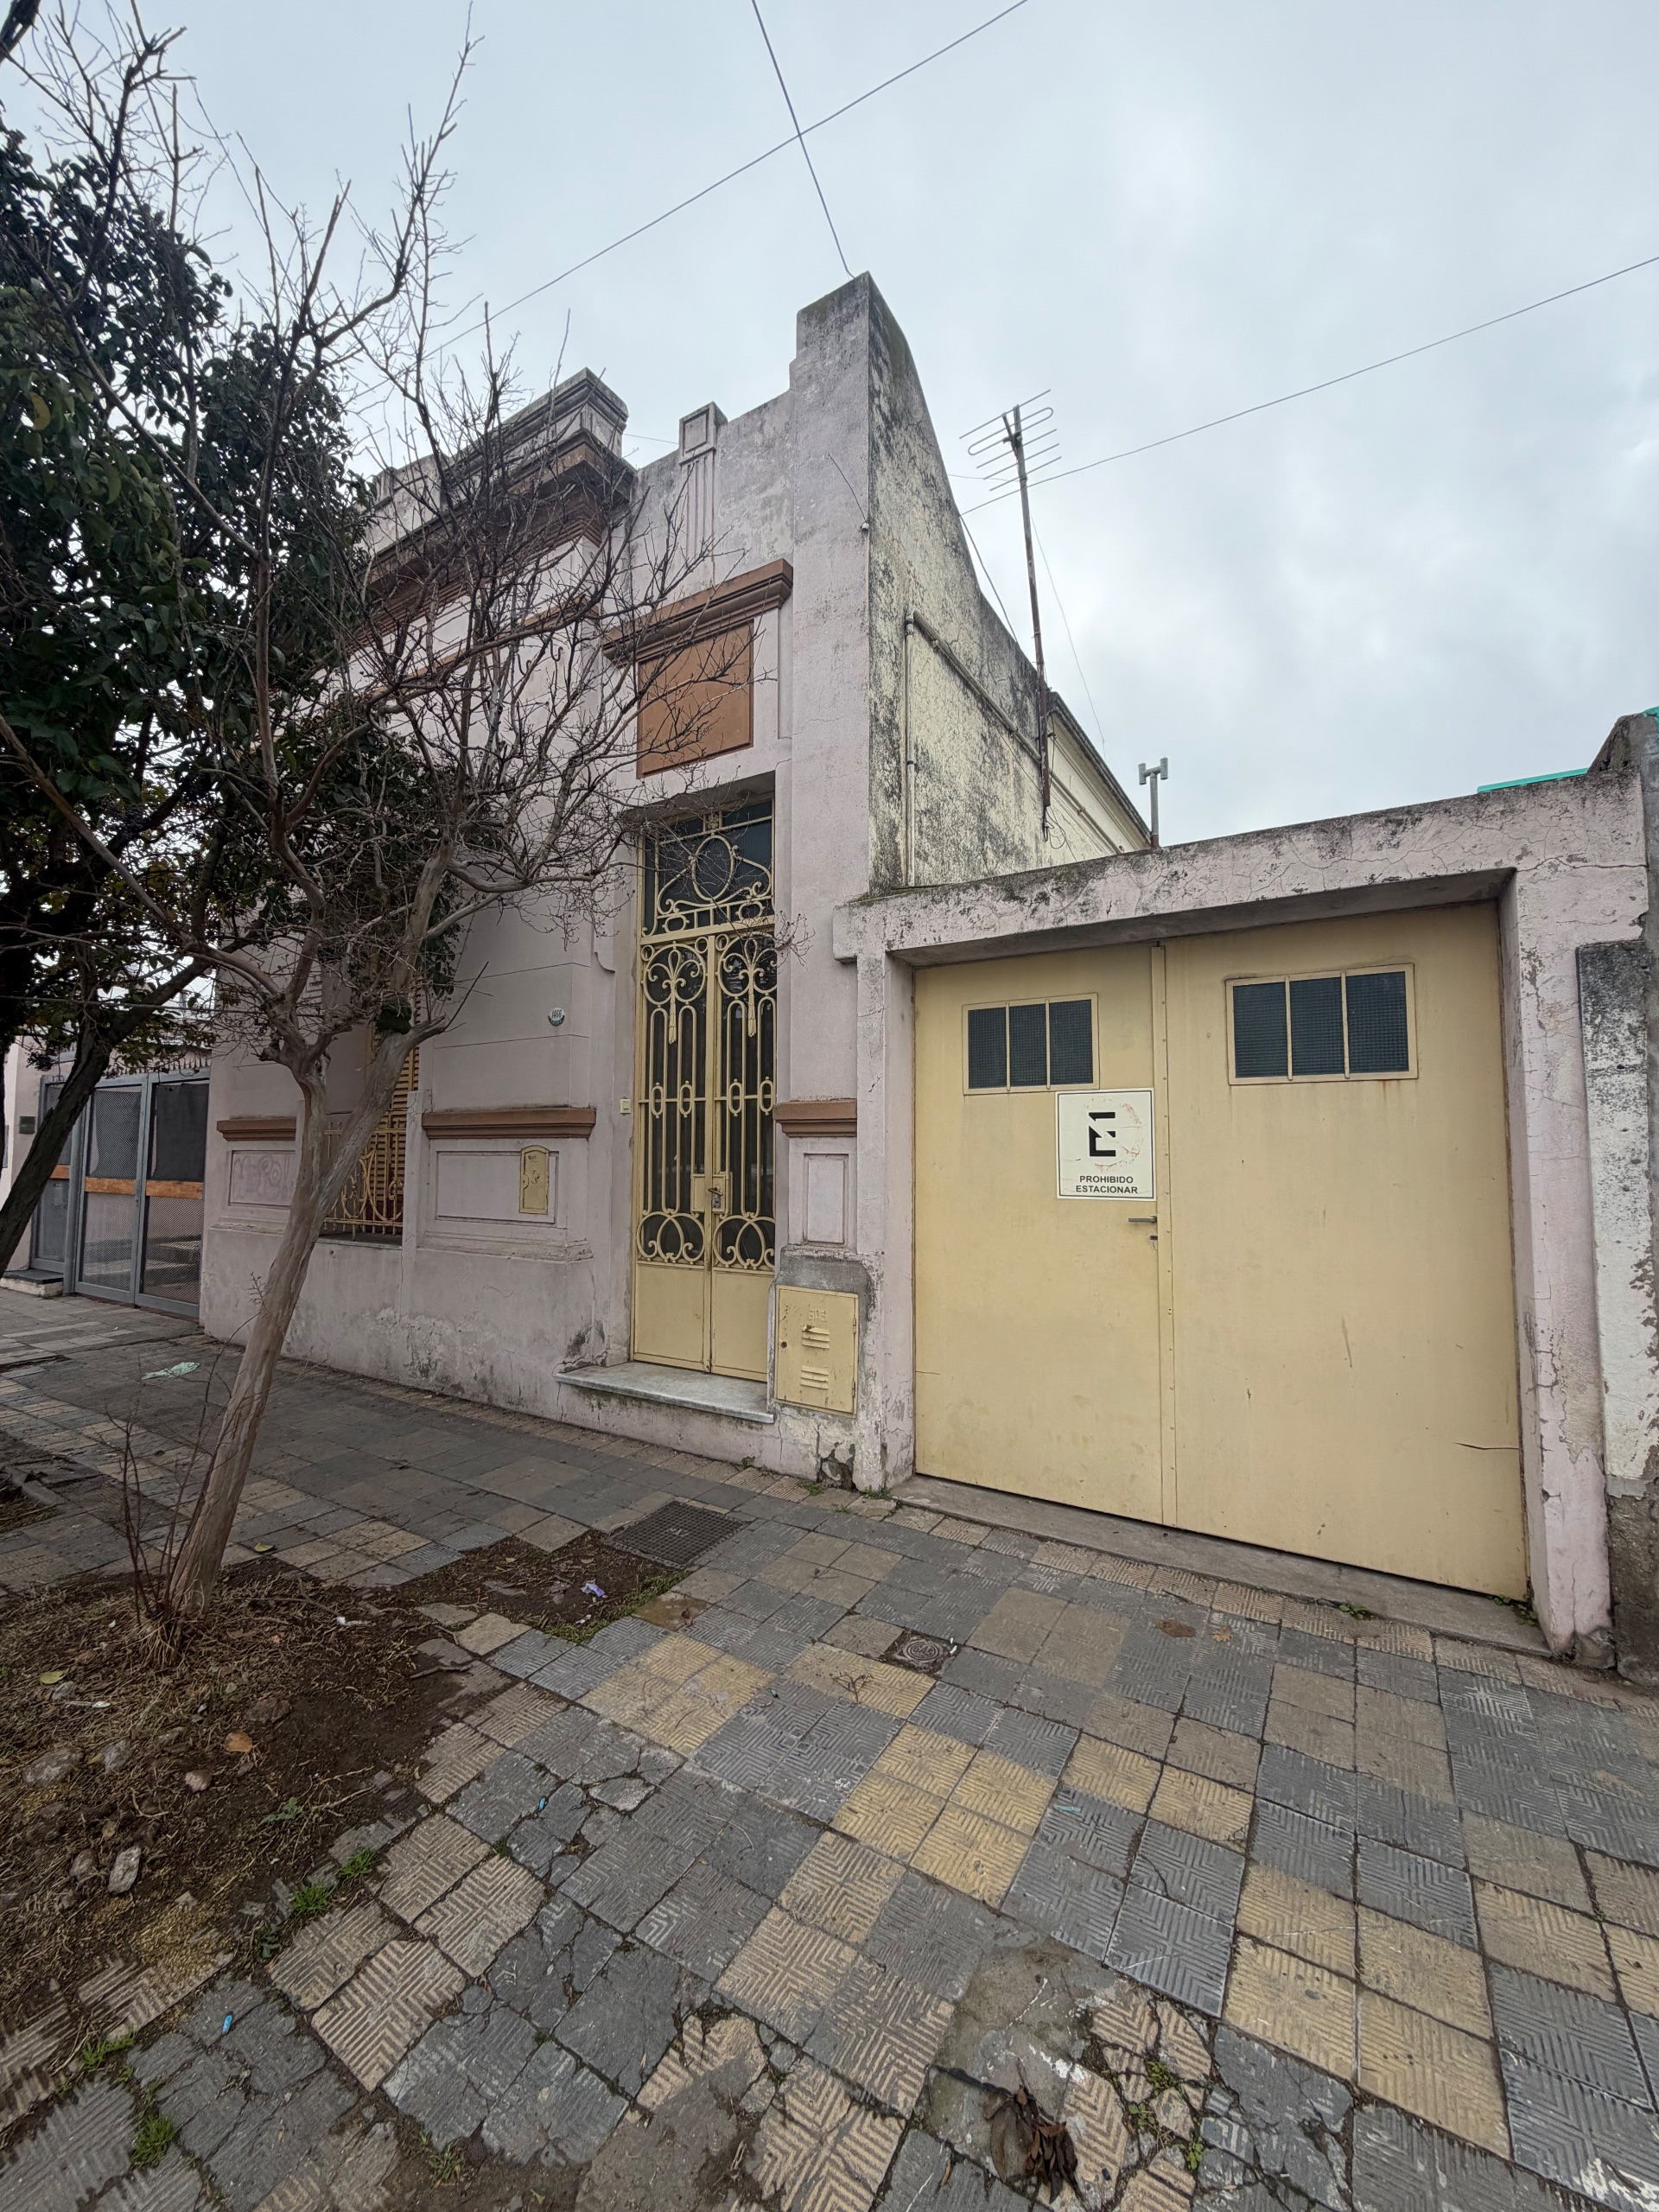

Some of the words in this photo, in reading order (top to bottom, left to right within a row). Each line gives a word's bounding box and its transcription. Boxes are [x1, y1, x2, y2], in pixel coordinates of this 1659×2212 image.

[1088, 1111, 1116, 1157] E
[1079, 1175, 1134, 1184] PROHIBIDO
[1076, 1185, 1138, 1194] ESTACIONAR
